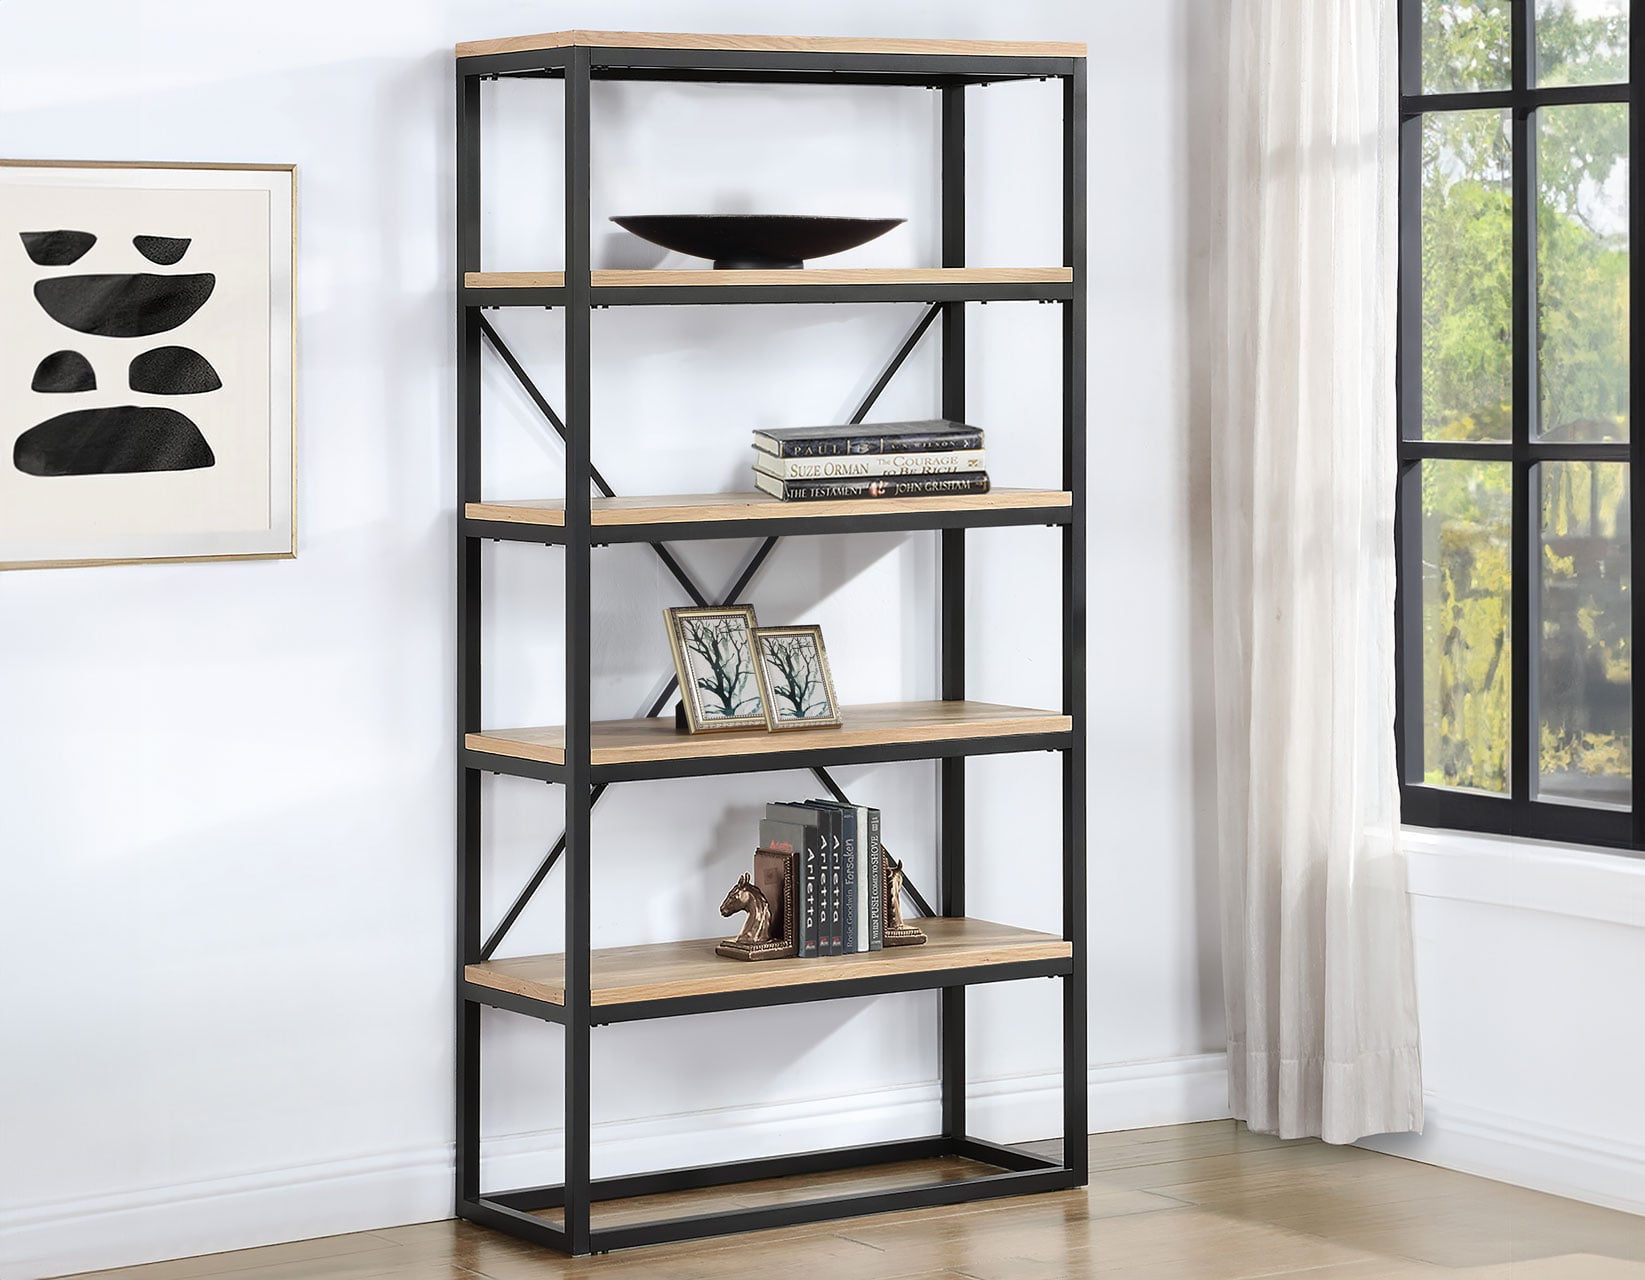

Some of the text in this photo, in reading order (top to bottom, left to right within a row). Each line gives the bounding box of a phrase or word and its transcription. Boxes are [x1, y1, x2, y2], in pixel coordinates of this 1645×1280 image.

[794, 444, 840, 455] PAUL
[790, 461, 869, 477] SUZE ORMAN
[893, 455, 959, 467] COURAGE
[790, 487, 862, 498] THE TESTAMENT
[895, 480, 971, 495] JOHN GRISHAM
[871, 835, 879, 864] SHOVE
[843, 838, 855, 885] Forsaken
[807, 848, 815, 928] Arletta
[820, 835, 828, 922] Arletta
[871, 896, 879, 919] PUSH
